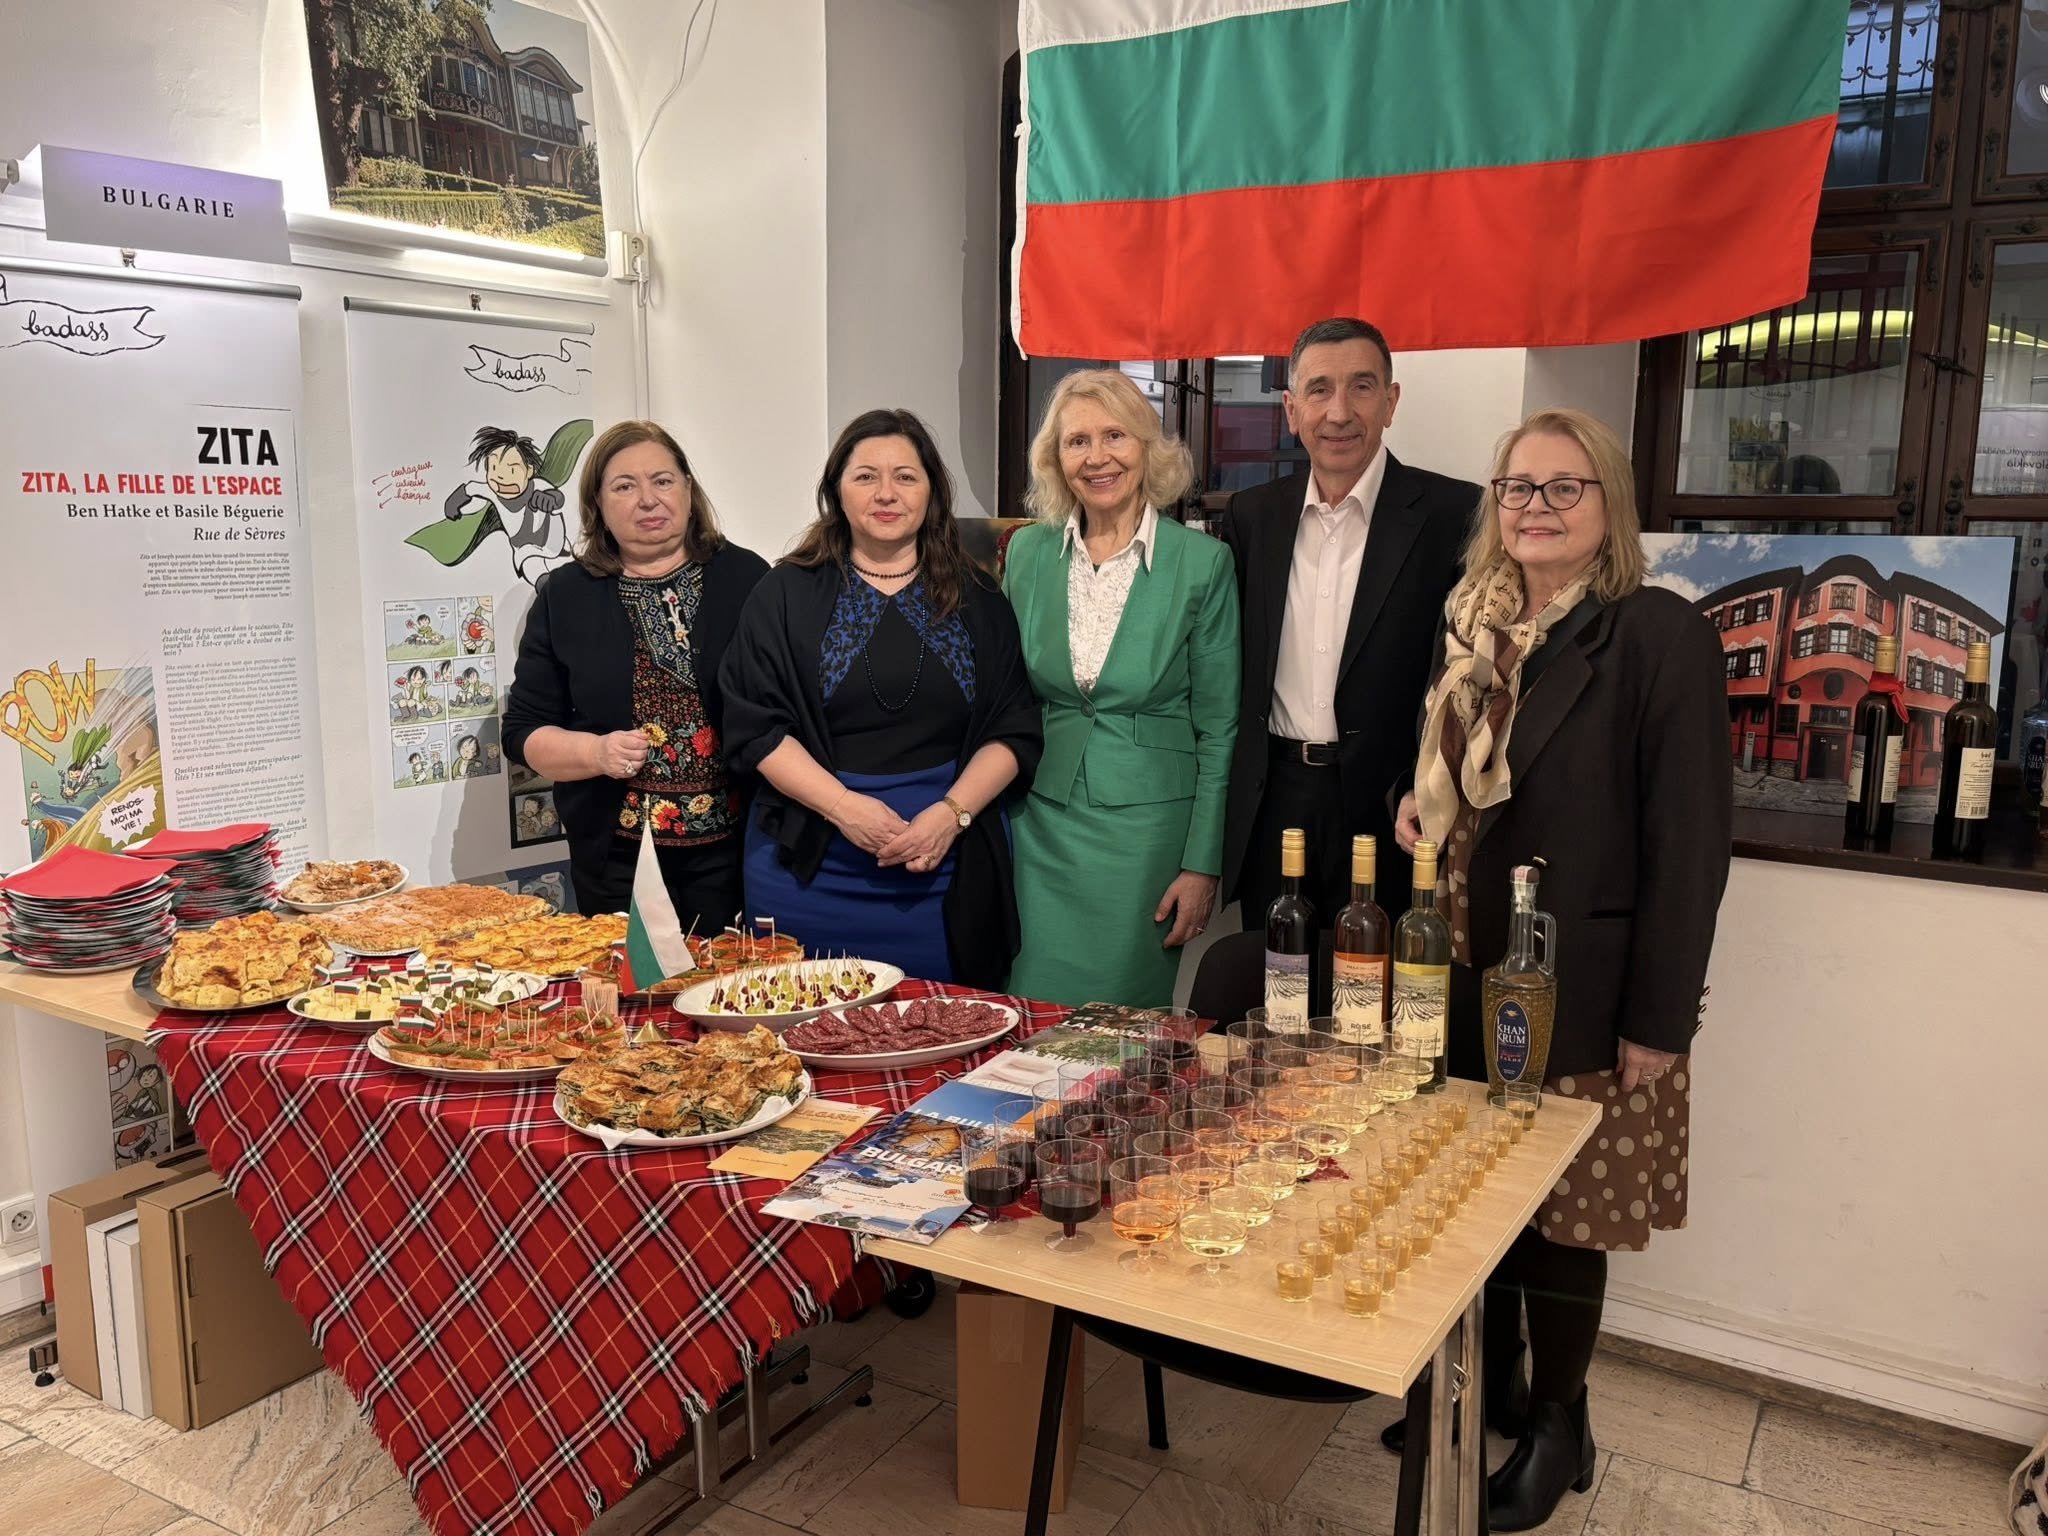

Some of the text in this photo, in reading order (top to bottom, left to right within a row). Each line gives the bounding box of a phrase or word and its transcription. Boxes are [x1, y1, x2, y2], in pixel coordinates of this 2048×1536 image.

[102, 186, 236, 218] BULGARIE
[22, 310, 110, 341] badass
[492, 358, 546, 382] badass
[197, 427, 279, 466] ZITA
[22, 472, 283, 496] ZITA, LA FILLE DE L'ESPACE
[67, 503, 285, 523] Ben Hatke et Basile Béguerie
[193, 526, 286, 541] Rue de Sèvres
[0, 658, 96, 766] POW
[111, 797, 144, 816] RENDS-
[110, 808, 143, 826] MOI MA
[121, 819, 142, 832] VIE !
[1497, 1023, 1526, 1035] KHAN
[1497, 1032, 1526, 1044] KRUM
[794, 1107, 861, 1122] ULGARIE
[908, 1108, 939, 1120] LA
[859, 1146, 963, 1175] BULGAR
